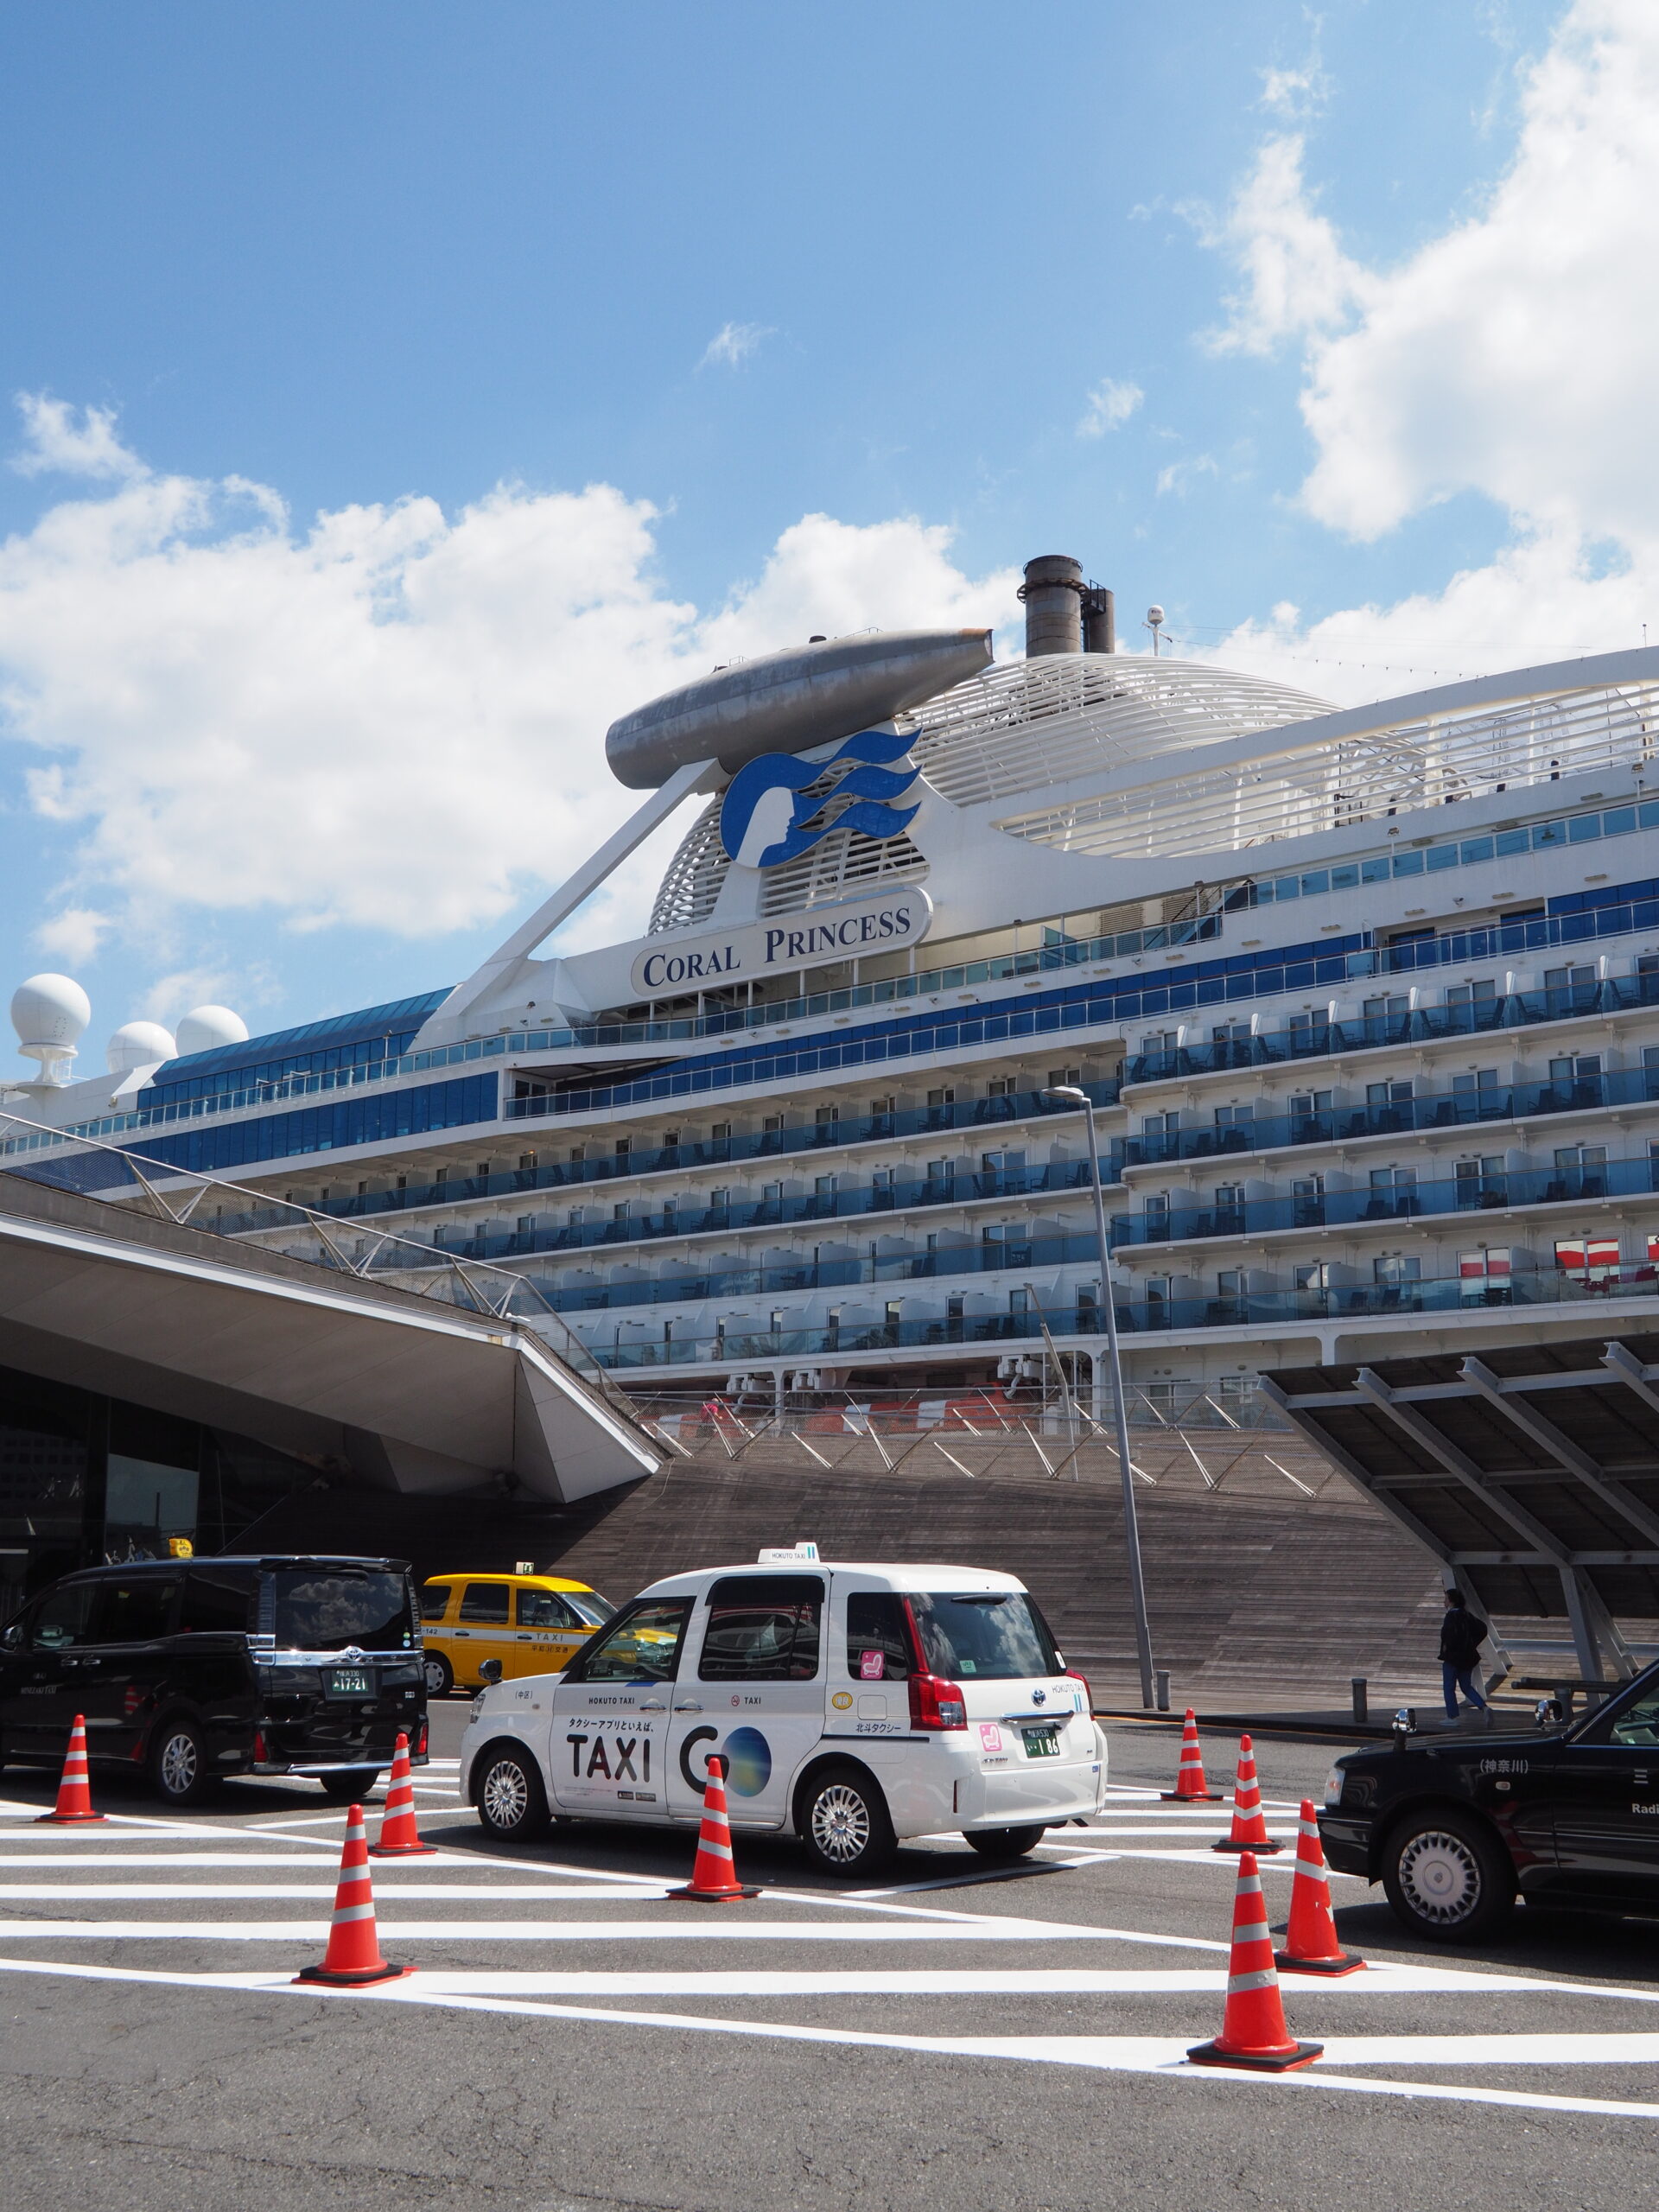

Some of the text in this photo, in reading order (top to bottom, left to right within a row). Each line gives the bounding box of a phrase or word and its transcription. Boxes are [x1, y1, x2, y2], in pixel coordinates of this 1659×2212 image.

[644, 907, 912, 988] CORAL PRINCESS
[536, 1632, 563, 1642] TAXI
[744, 1696, 761, 1705] TAXI
[566, 1733, 651, 1783] TAXI
[1479, 1758, 1529, 1774] (神奈川)
